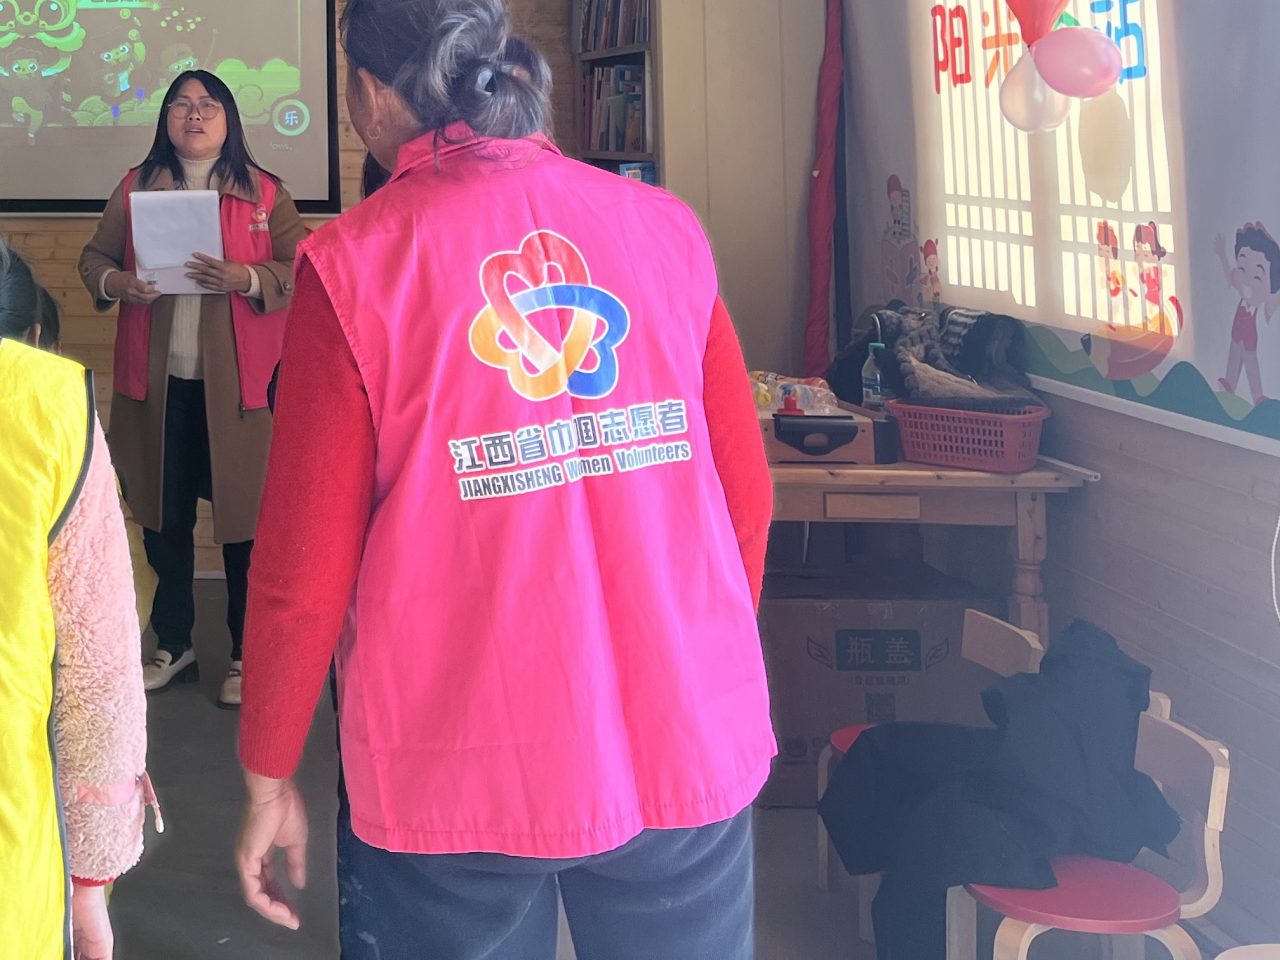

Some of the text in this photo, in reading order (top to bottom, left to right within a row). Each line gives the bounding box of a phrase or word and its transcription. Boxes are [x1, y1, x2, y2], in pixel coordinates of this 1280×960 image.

[450, 400, 687, 472] 江西省巾帼志愿者
[461, 464, 563, 500] JIANGXISHENG
[616, 442, 690, 470] Volunteers
[847, 636, 913, 665] 瓶盖
